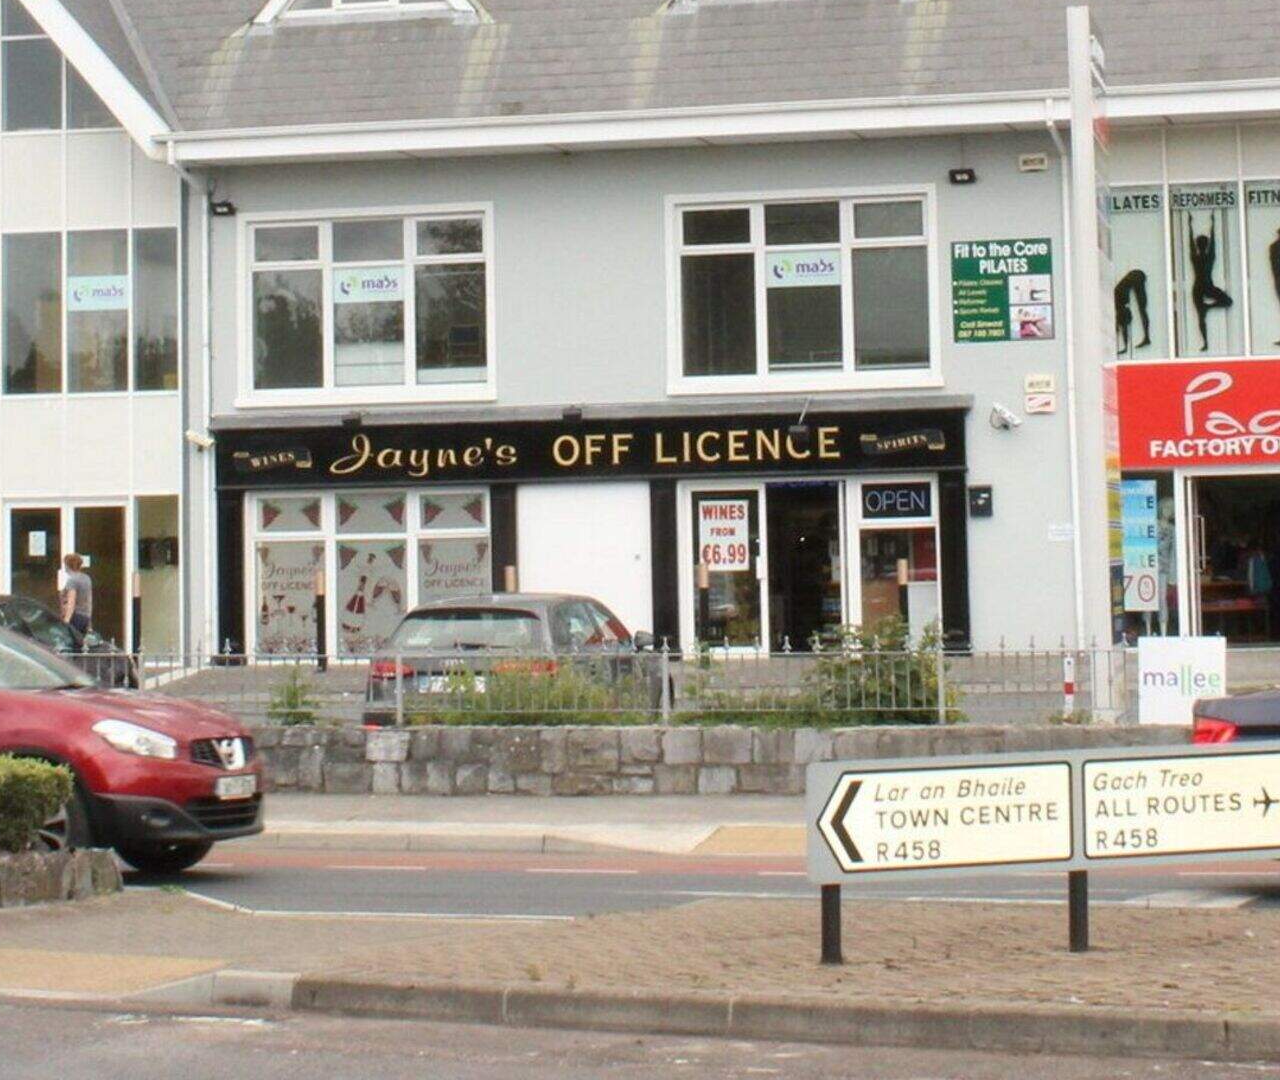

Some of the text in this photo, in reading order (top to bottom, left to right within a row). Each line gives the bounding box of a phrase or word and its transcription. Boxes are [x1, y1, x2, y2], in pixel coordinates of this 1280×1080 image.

[1112, 194, 1160, 210] LATES
[1172, 190, 1235, 208] REFORMERS
[954, 241, 1048, 258] Fit to the Core
[979, 258, 1028, 274] PILATES
[329, 426, 841, 477] Jayne's OFF LICENCE
[1149, 437, 1255, 457] FACTORY
[865, 489, 926, 512] OPEN
[702, 504, 745, 520] WINES
[710, 527, 736, 537] FROM
[702, 543, 747, 564] €6.99
[280, 576, 314, 590] LICENC
[1143, 664, 1220, 697] mallee
[920, 784, 945, 800] an
[957, 777, 1026, 798] Bhaile
[1092, 768, 1204, 792] Gach Treo
[875, 801, 1060, 830] TOWN CENTRE
[1095, 792, 1243, 818] ALL ROUTES
[1095, 828, 1159, 850] R458
[876, 839, 942, 863] R458
